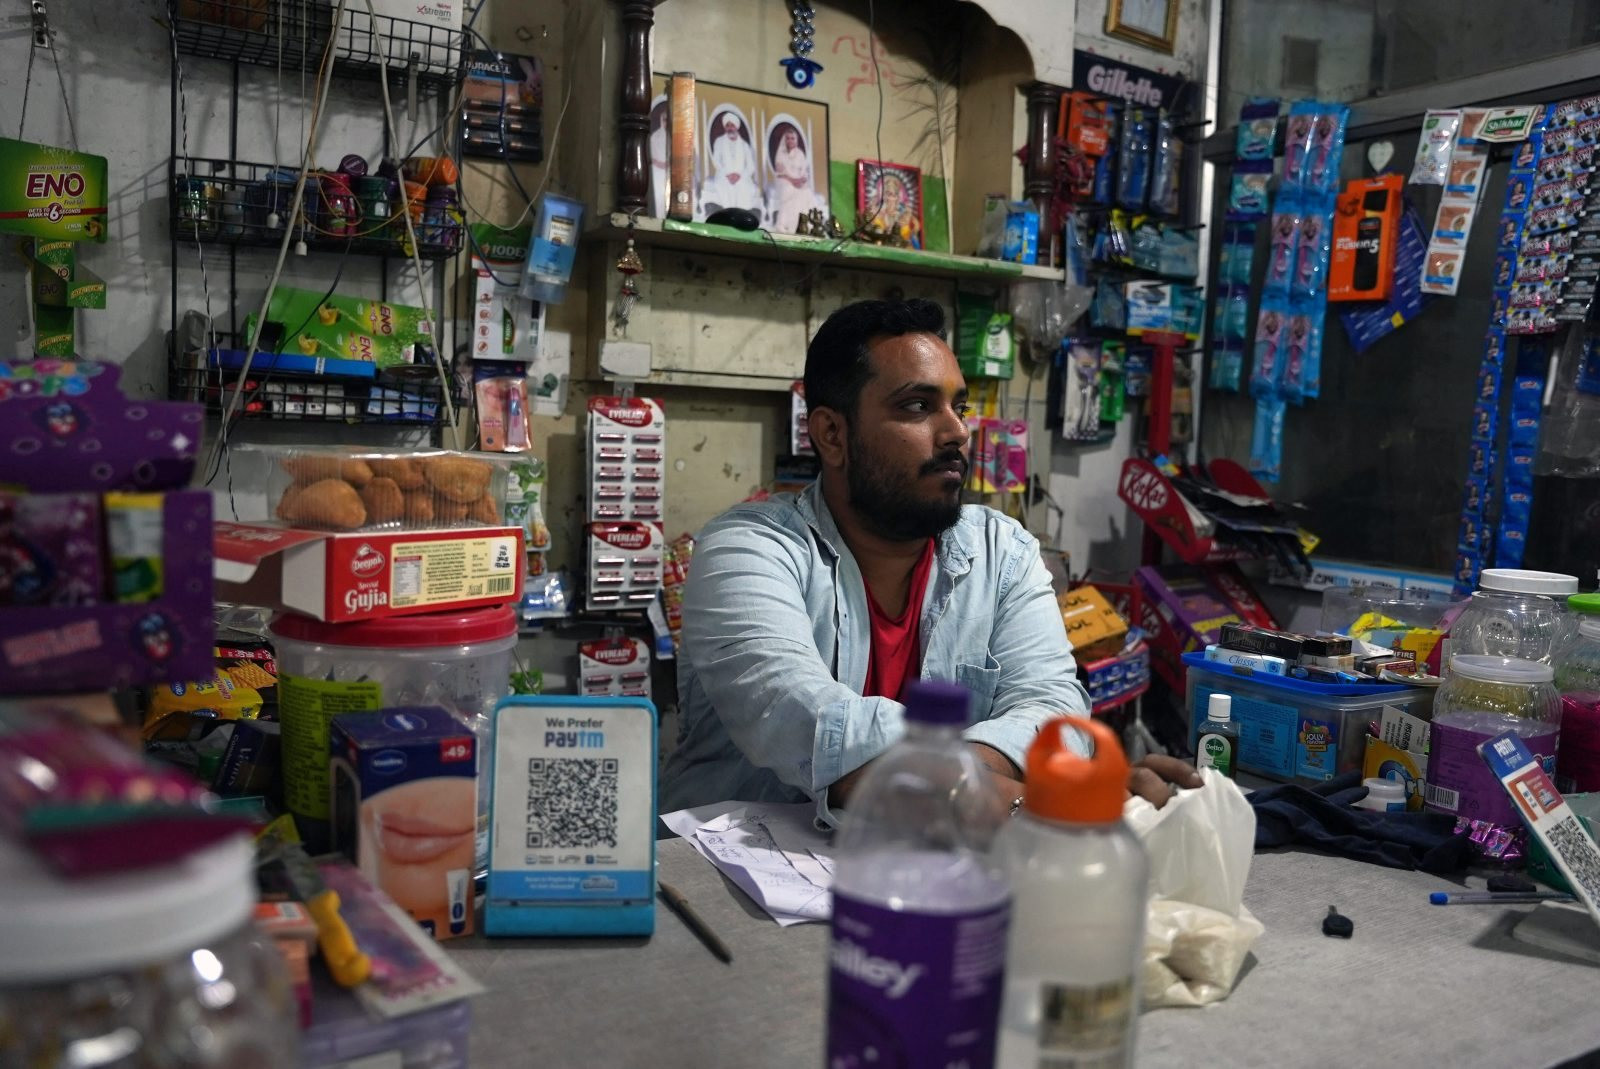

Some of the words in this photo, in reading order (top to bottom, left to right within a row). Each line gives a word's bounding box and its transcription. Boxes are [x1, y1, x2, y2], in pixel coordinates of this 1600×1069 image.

[1087, 65, 1163, 107] Gillette
[1488, 119, 1524, 131] Shikhar
[26, 172, 85, 198] ENO
[49, 204, 60, 221] 6
[380, 304, 392, 336] ENO
[608, 408, 646, 419] EVEREADY
[607, 532, 646, 543] EVEREADY
[353, 553, 383, 570] Deepak
[345, 588, 389, 614] Gujia
[595, 648, 632, 660] EVEREADY
[1228, 655, 1258, 668] Classic
[546, 718, 565, 728] We
[567, 717, 605, 728] Prefer
[545, 731, 604, 748] paytm
[1306, 732, 1325, 742] JOLLY
[1206, 743, 1223, 752] Dettol
